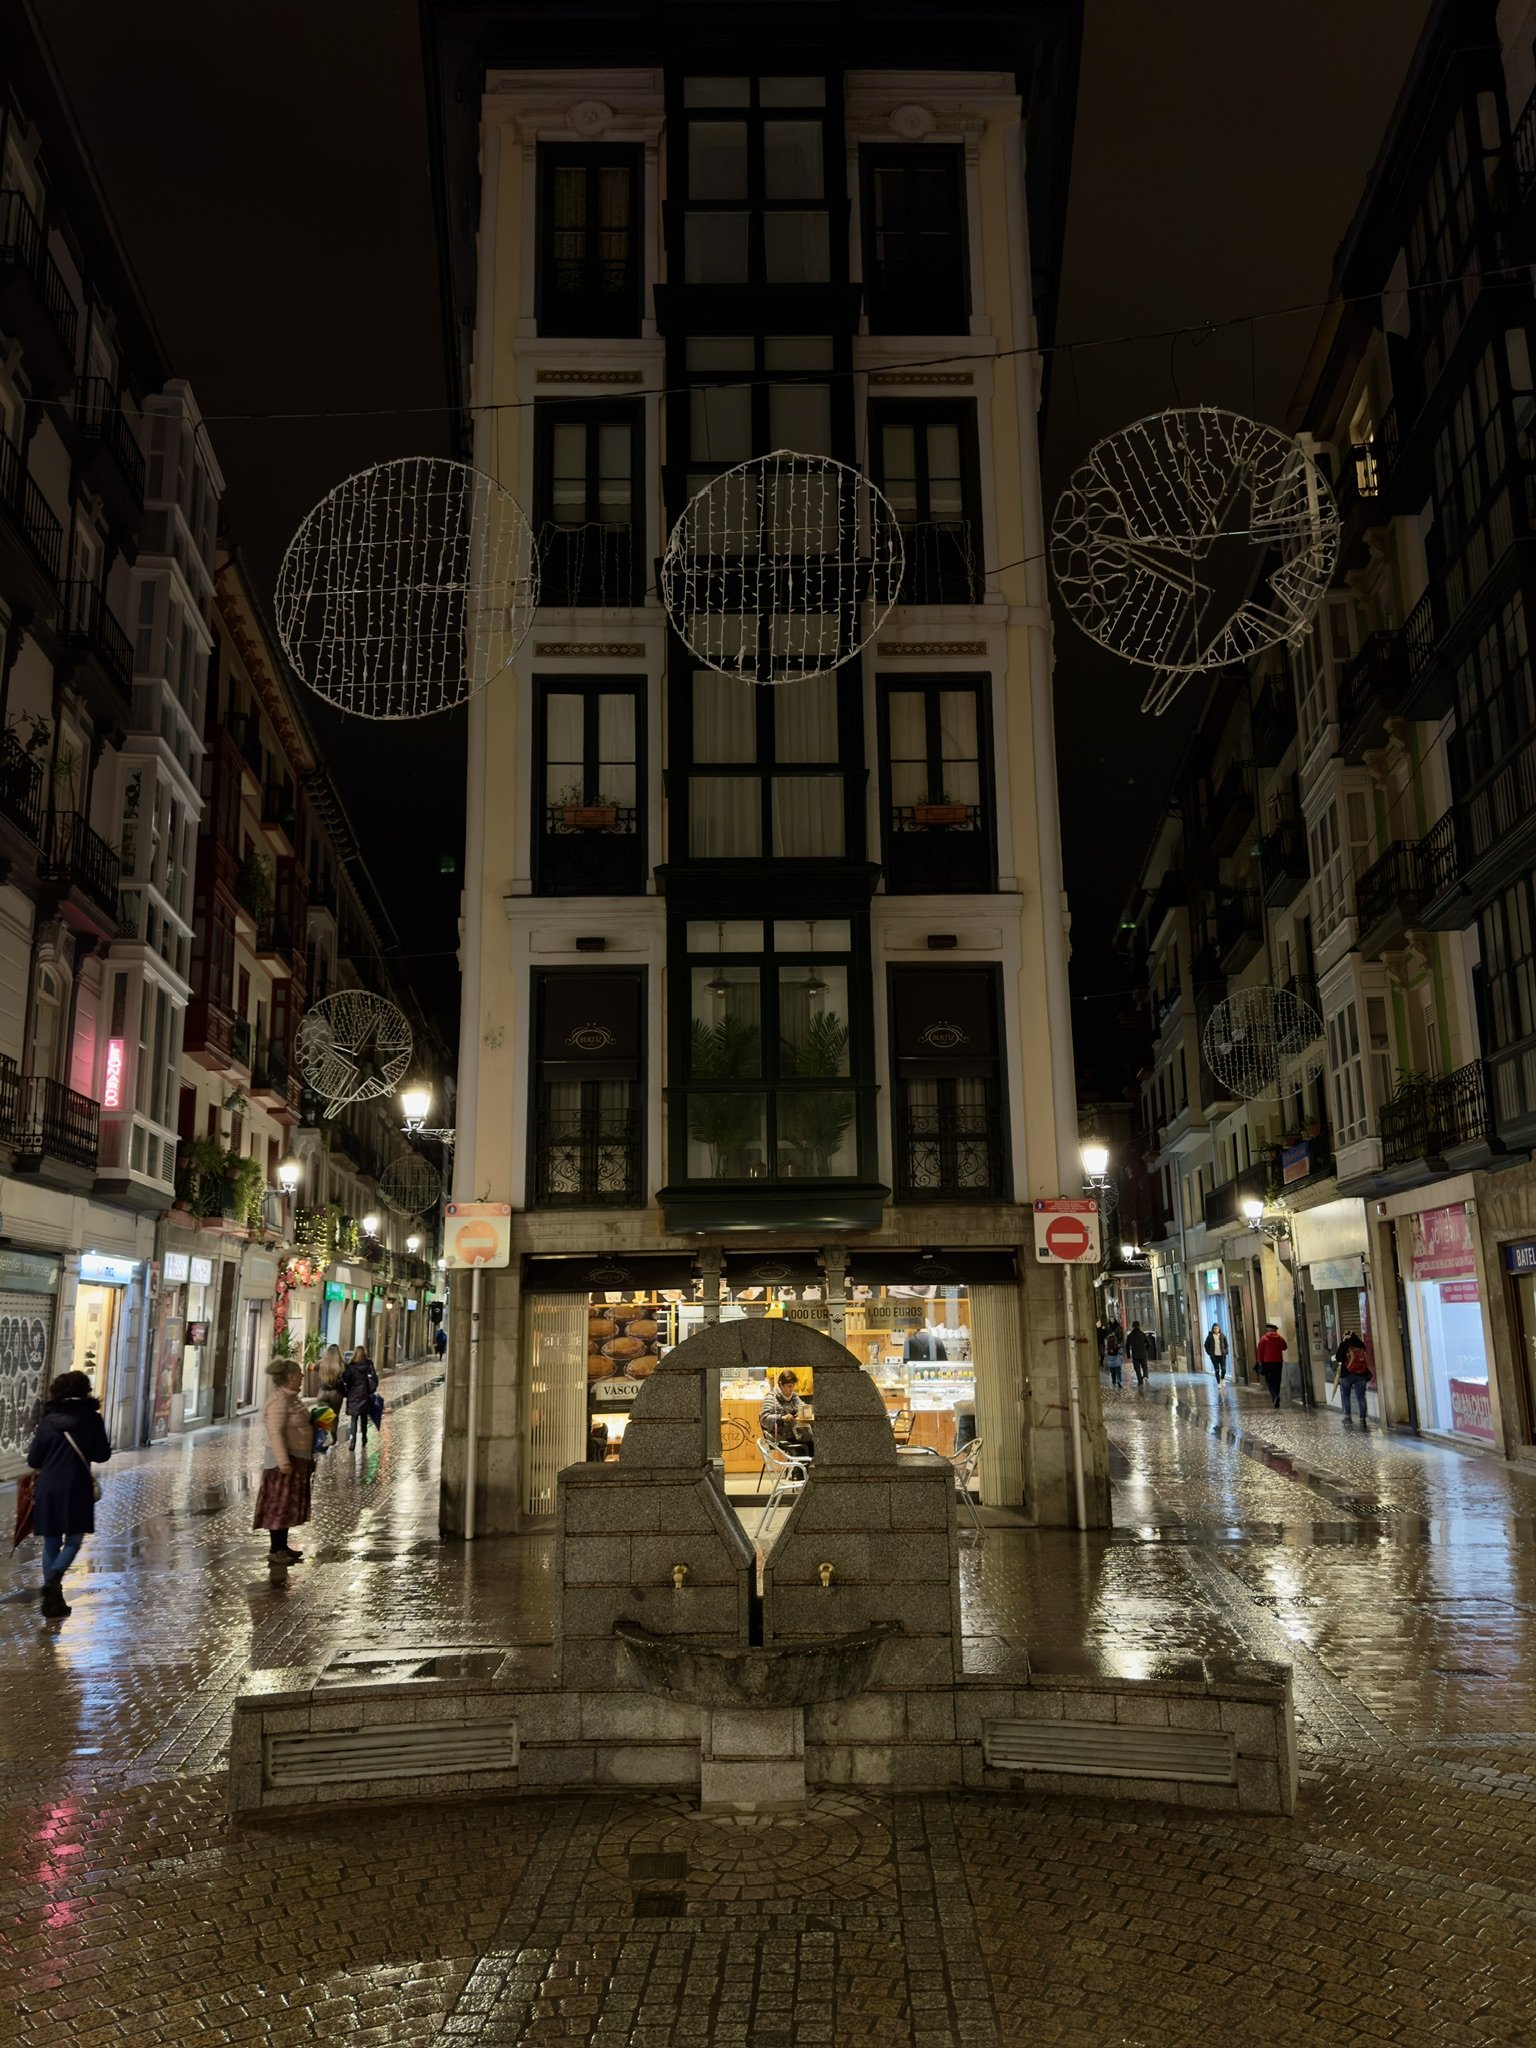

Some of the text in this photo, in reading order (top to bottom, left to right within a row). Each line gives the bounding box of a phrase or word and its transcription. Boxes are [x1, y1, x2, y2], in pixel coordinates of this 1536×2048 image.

[1516, 1247, 1536, 1267] BATEL
[893, 1306, 923, 1317] EUROS
[604, 1385, 639, 1395] VASCO
